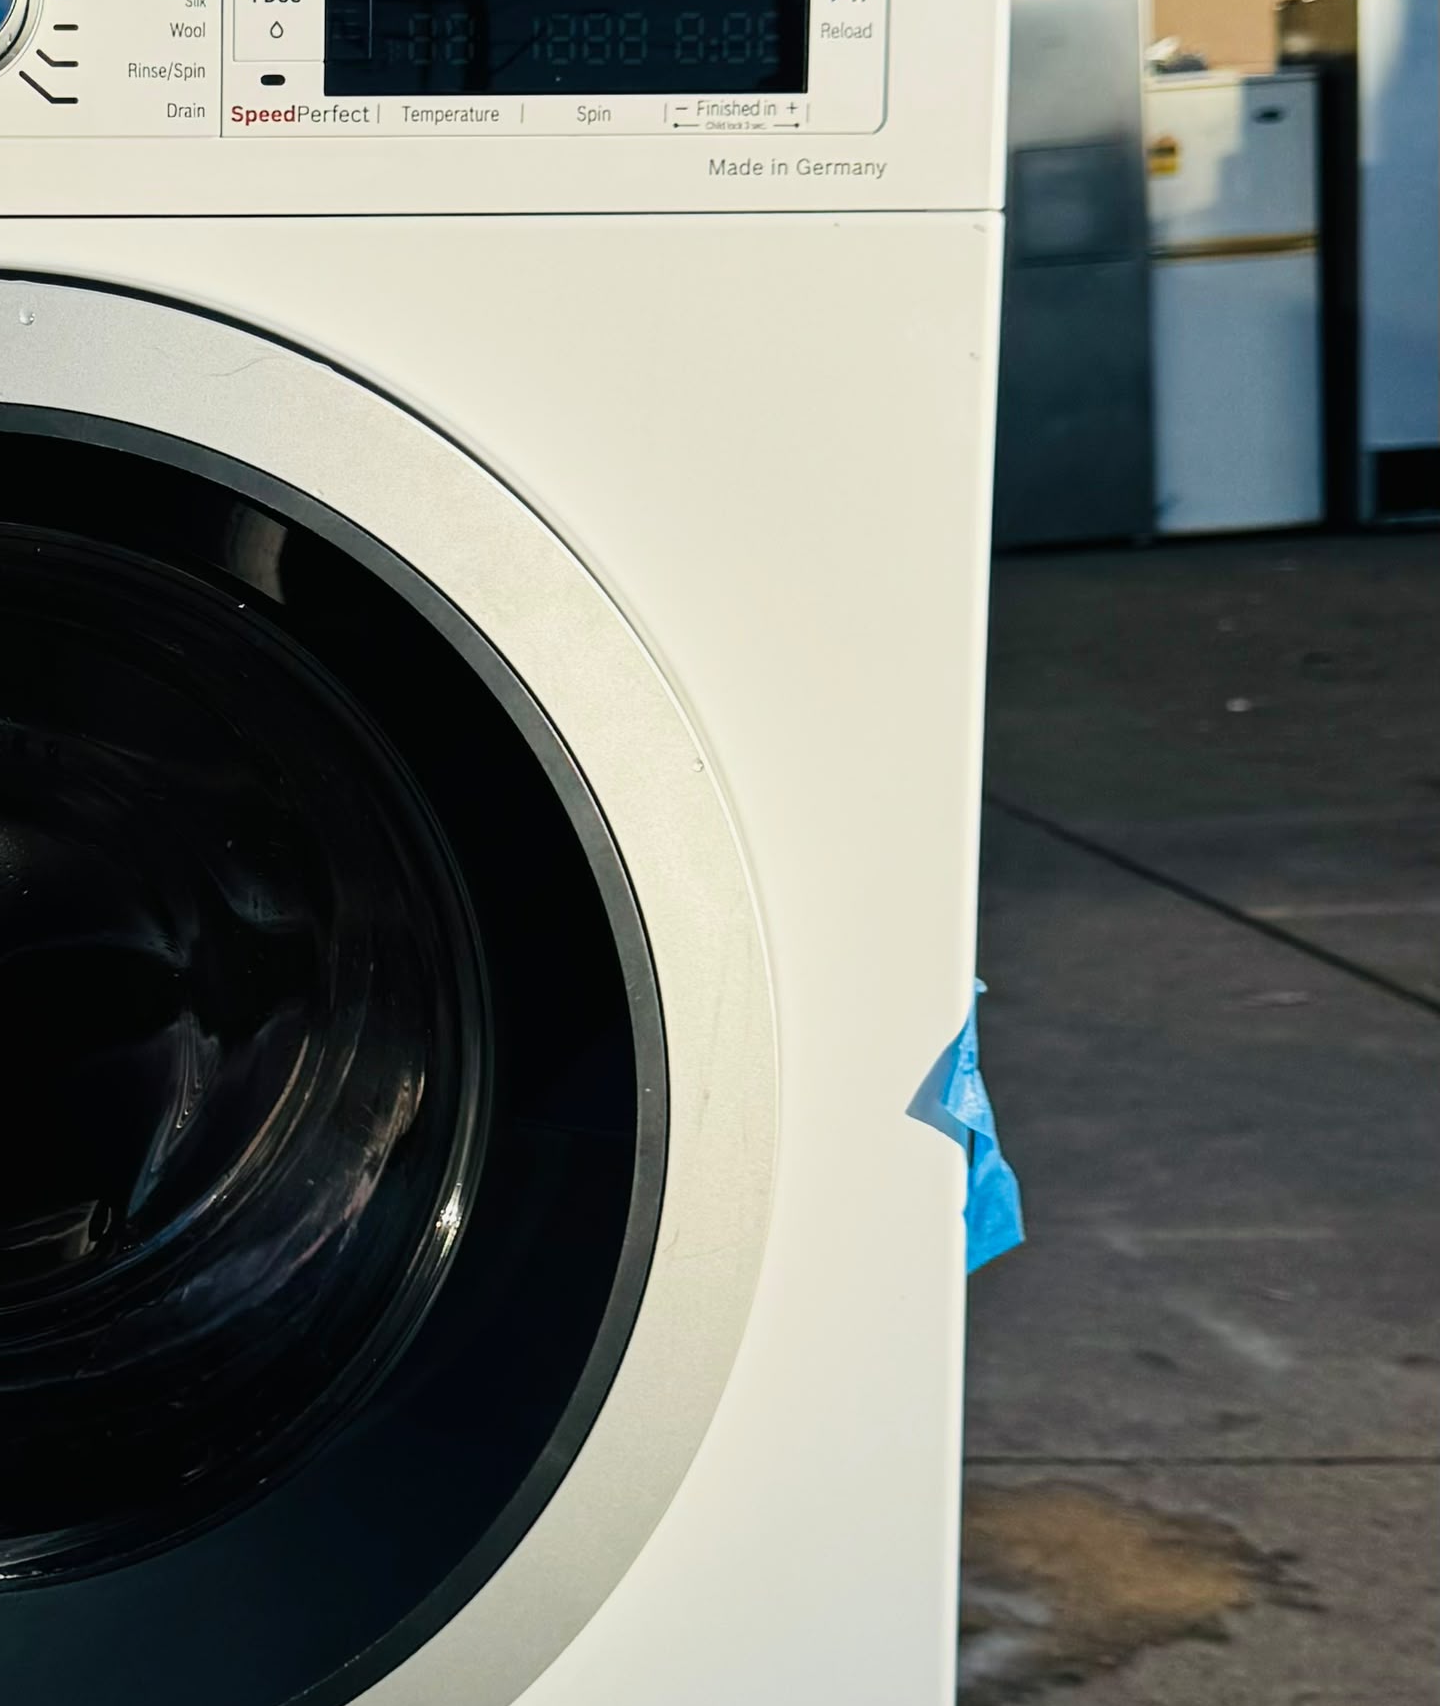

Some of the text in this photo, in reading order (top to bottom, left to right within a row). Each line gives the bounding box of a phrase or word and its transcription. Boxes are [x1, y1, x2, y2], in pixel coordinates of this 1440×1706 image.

[170, 22, 205, 38] Wool
[821, 23, 872, 39] Reload
[129, 63, 205, 81] Rinse/Spin
[167, 103, 205, 118] Drain
[231, 105, 370, 126] SpeedPerfect
[402, 106, 499, 125] Temperature
[577, 106, 611, 125] Spin
[697, 100, 776, 116] Finished in
[709, 159, 886, 179] Made in Germany
